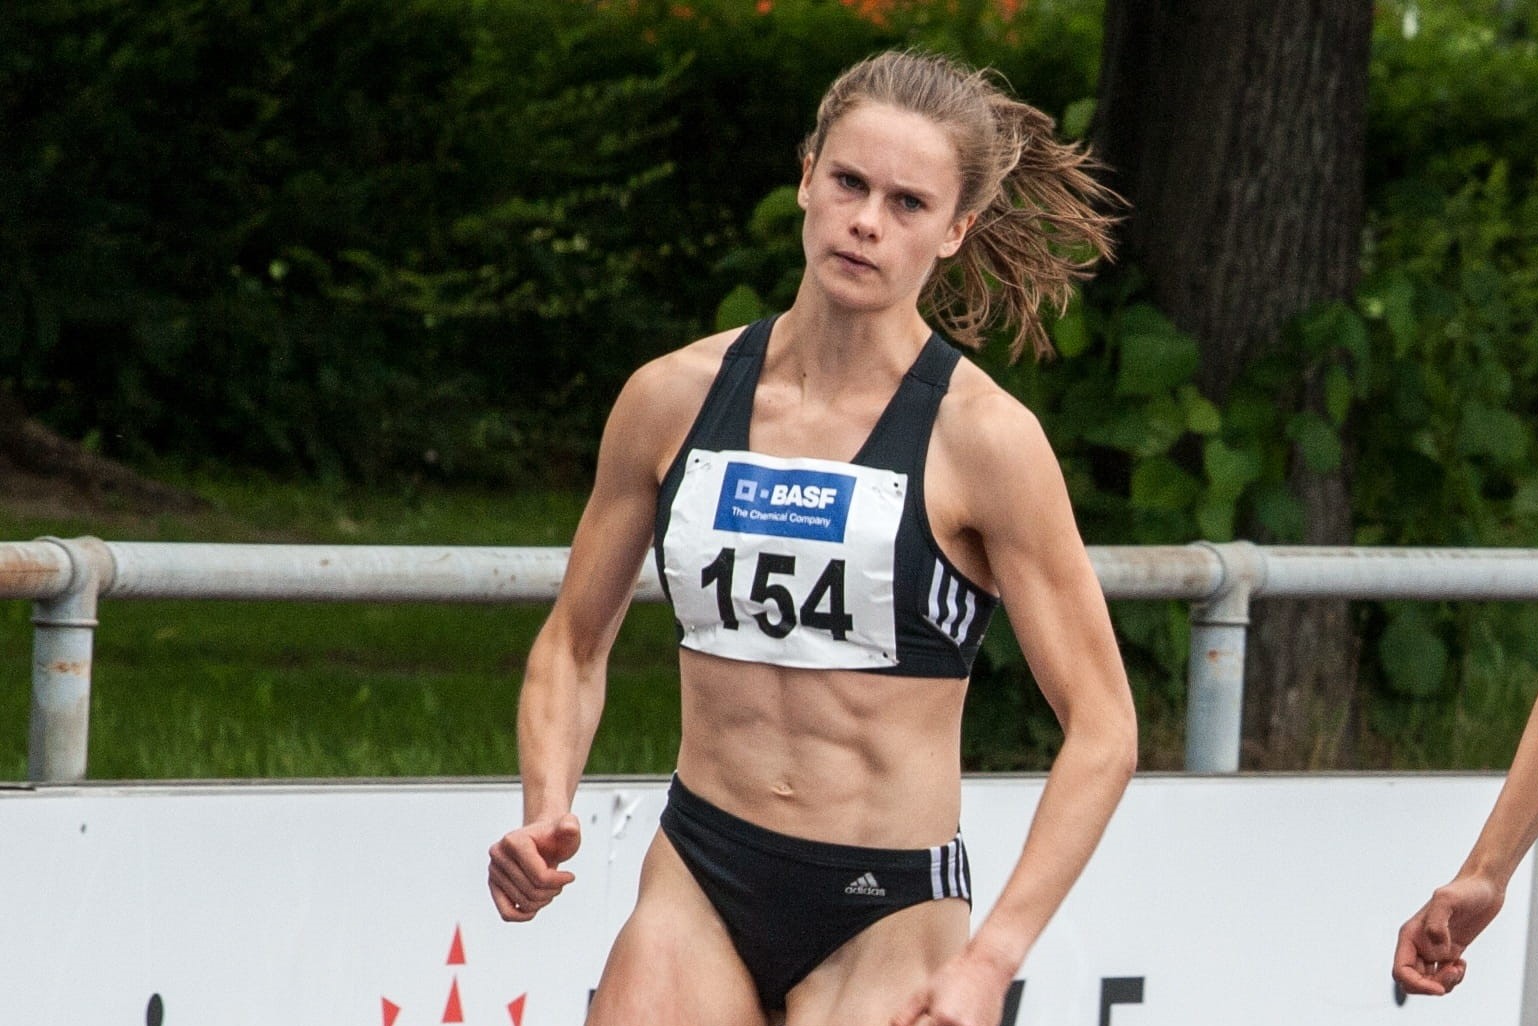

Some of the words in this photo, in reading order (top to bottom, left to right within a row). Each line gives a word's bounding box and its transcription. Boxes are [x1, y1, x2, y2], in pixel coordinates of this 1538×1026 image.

[771, 484, 837, 509] BASF
[731, 506, 748, 519] The
[749, 508, 788, 523] Chemical
[789, 511, 831, 528] Company
[701, 547, 854, 641] 154
[844, 886, 886, 896] adidas
